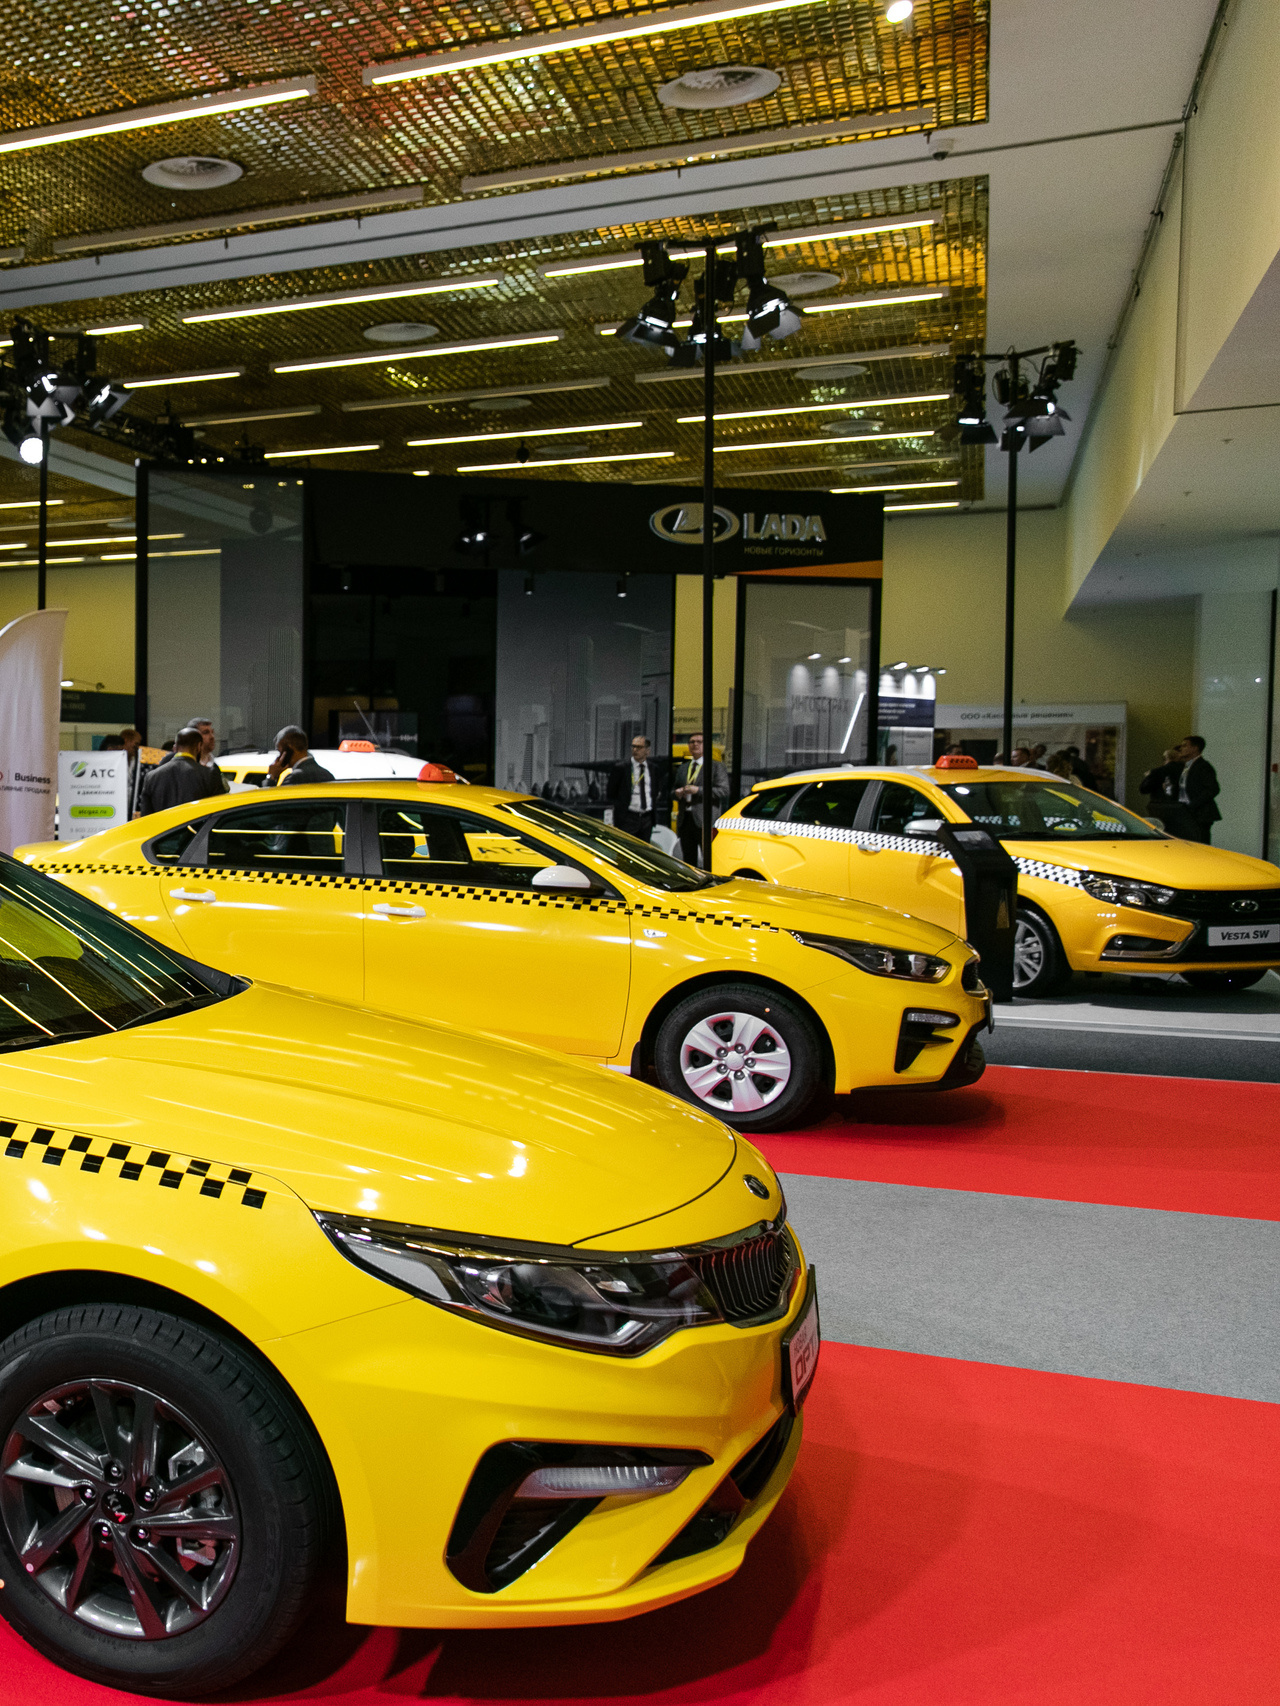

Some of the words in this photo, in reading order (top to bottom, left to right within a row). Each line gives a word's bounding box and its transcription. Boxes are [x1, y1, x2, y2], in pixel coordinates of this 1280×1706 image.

[743, 512, 827, 542] LADA
[14, 772, 51, 785] Business
[24, 787, 51, 795] ПРОДАЖИ
[1252, 930, 1270, 939] SW
